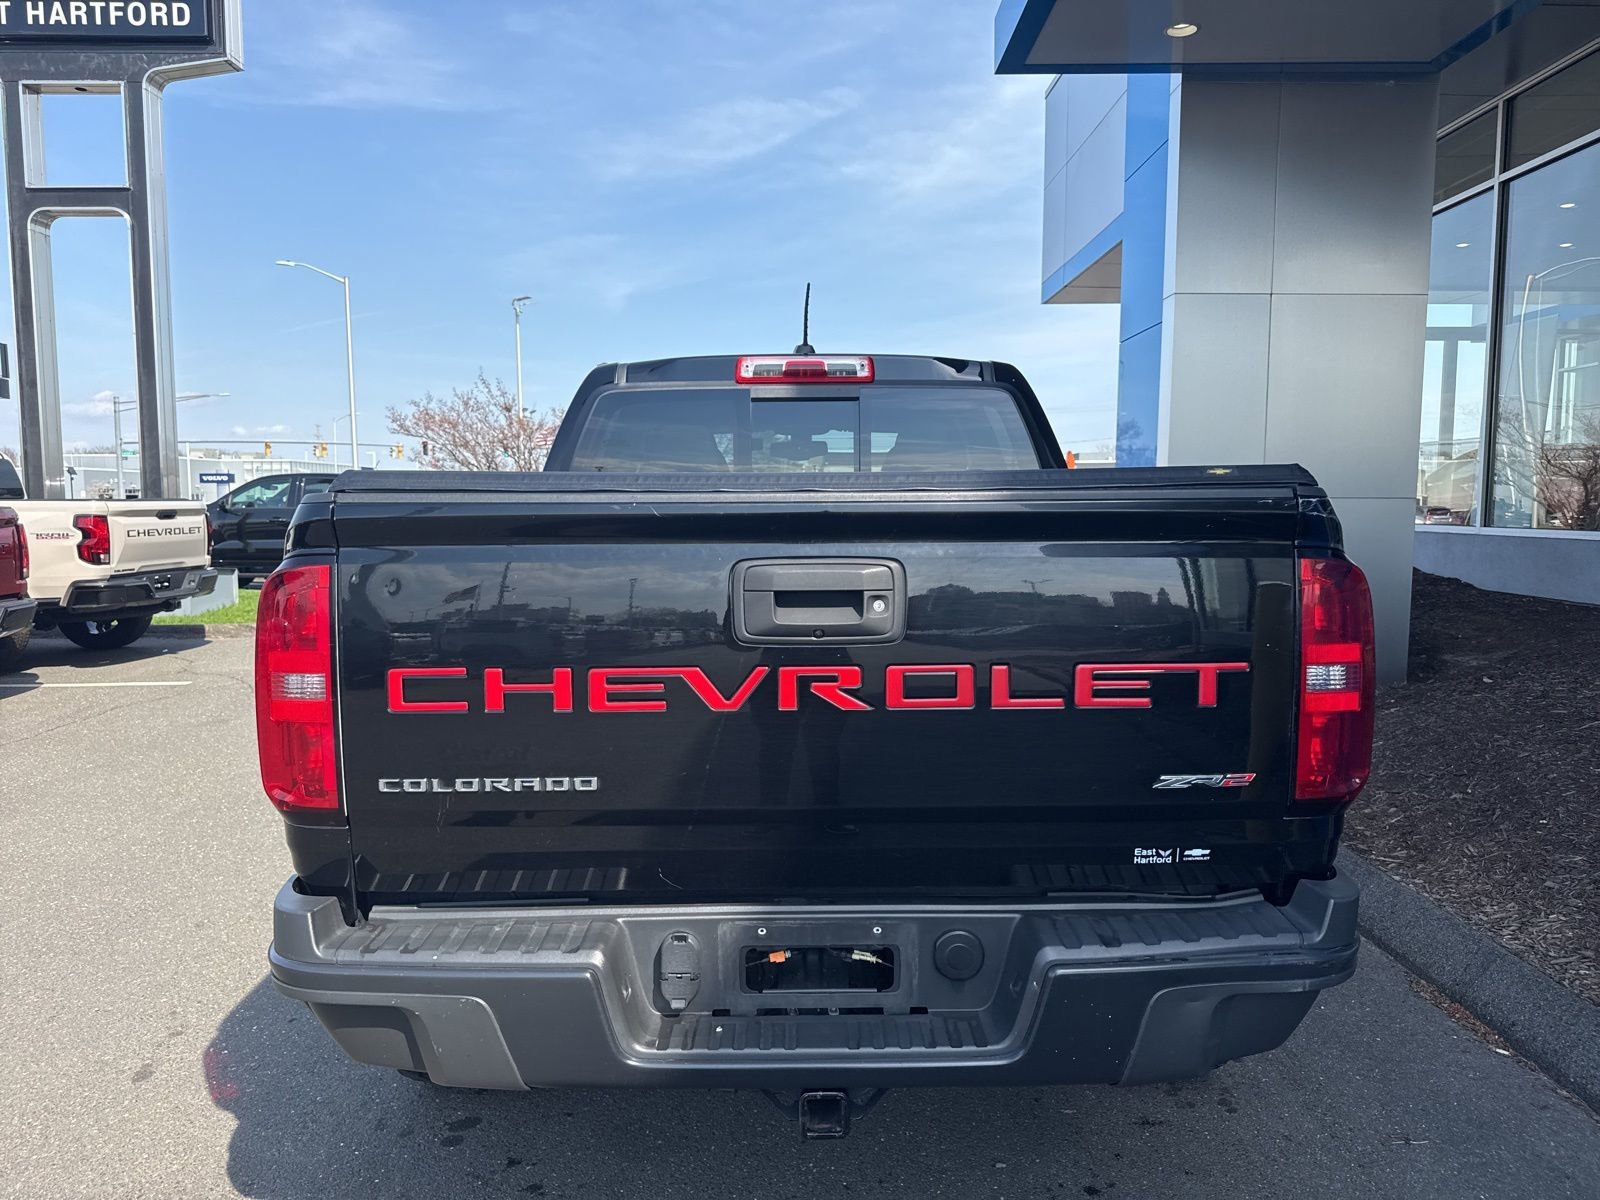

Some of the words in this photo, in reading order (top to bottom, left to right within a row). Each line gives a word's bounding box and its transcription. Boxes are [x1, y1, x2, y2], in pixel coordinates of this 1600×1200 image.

[27, 1, 191, 26] HARTFORD
[127, 527, 202, 537] CHEVROLET
[387, 663, 1250, 713] CHEVROLET
[378, 777, 598, 793] COLORADO
[1152, 773, 1256, 789] ZR2
[1134, 848, 1156, 856] East
[1134, 855, 1172, 864] Hartford
